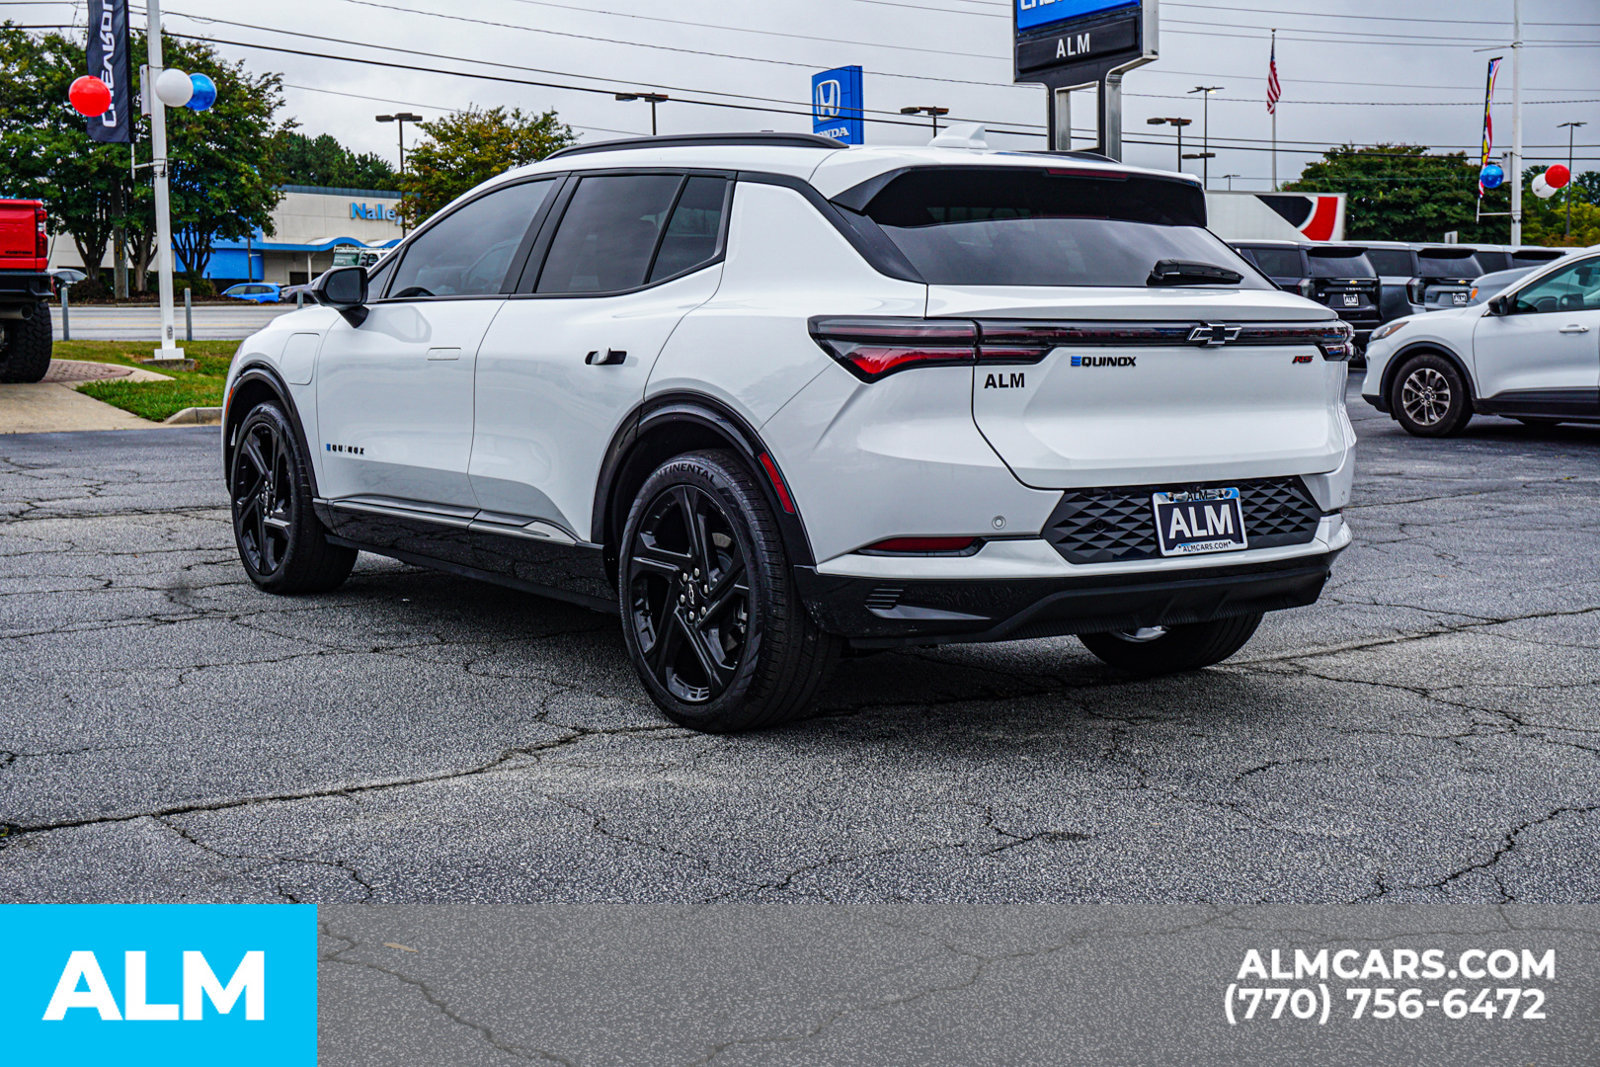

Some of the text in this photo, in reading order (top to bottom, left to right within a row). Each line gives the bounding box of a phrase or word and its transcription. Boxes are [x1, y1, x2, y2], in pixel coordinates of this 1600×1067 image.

[1056, 33, 1090, 58] ALM
[1071, 355, 1136, 367] EQUINOX
[1292, 355, 1314, 364] RS
[984, 372, 1025, 389] ALM
[1187, 490, 1208, 501] ALM
[1168, 504, 1234, 539] ALM
[1182, 542, 1229, 553] ALMCARS.COM
